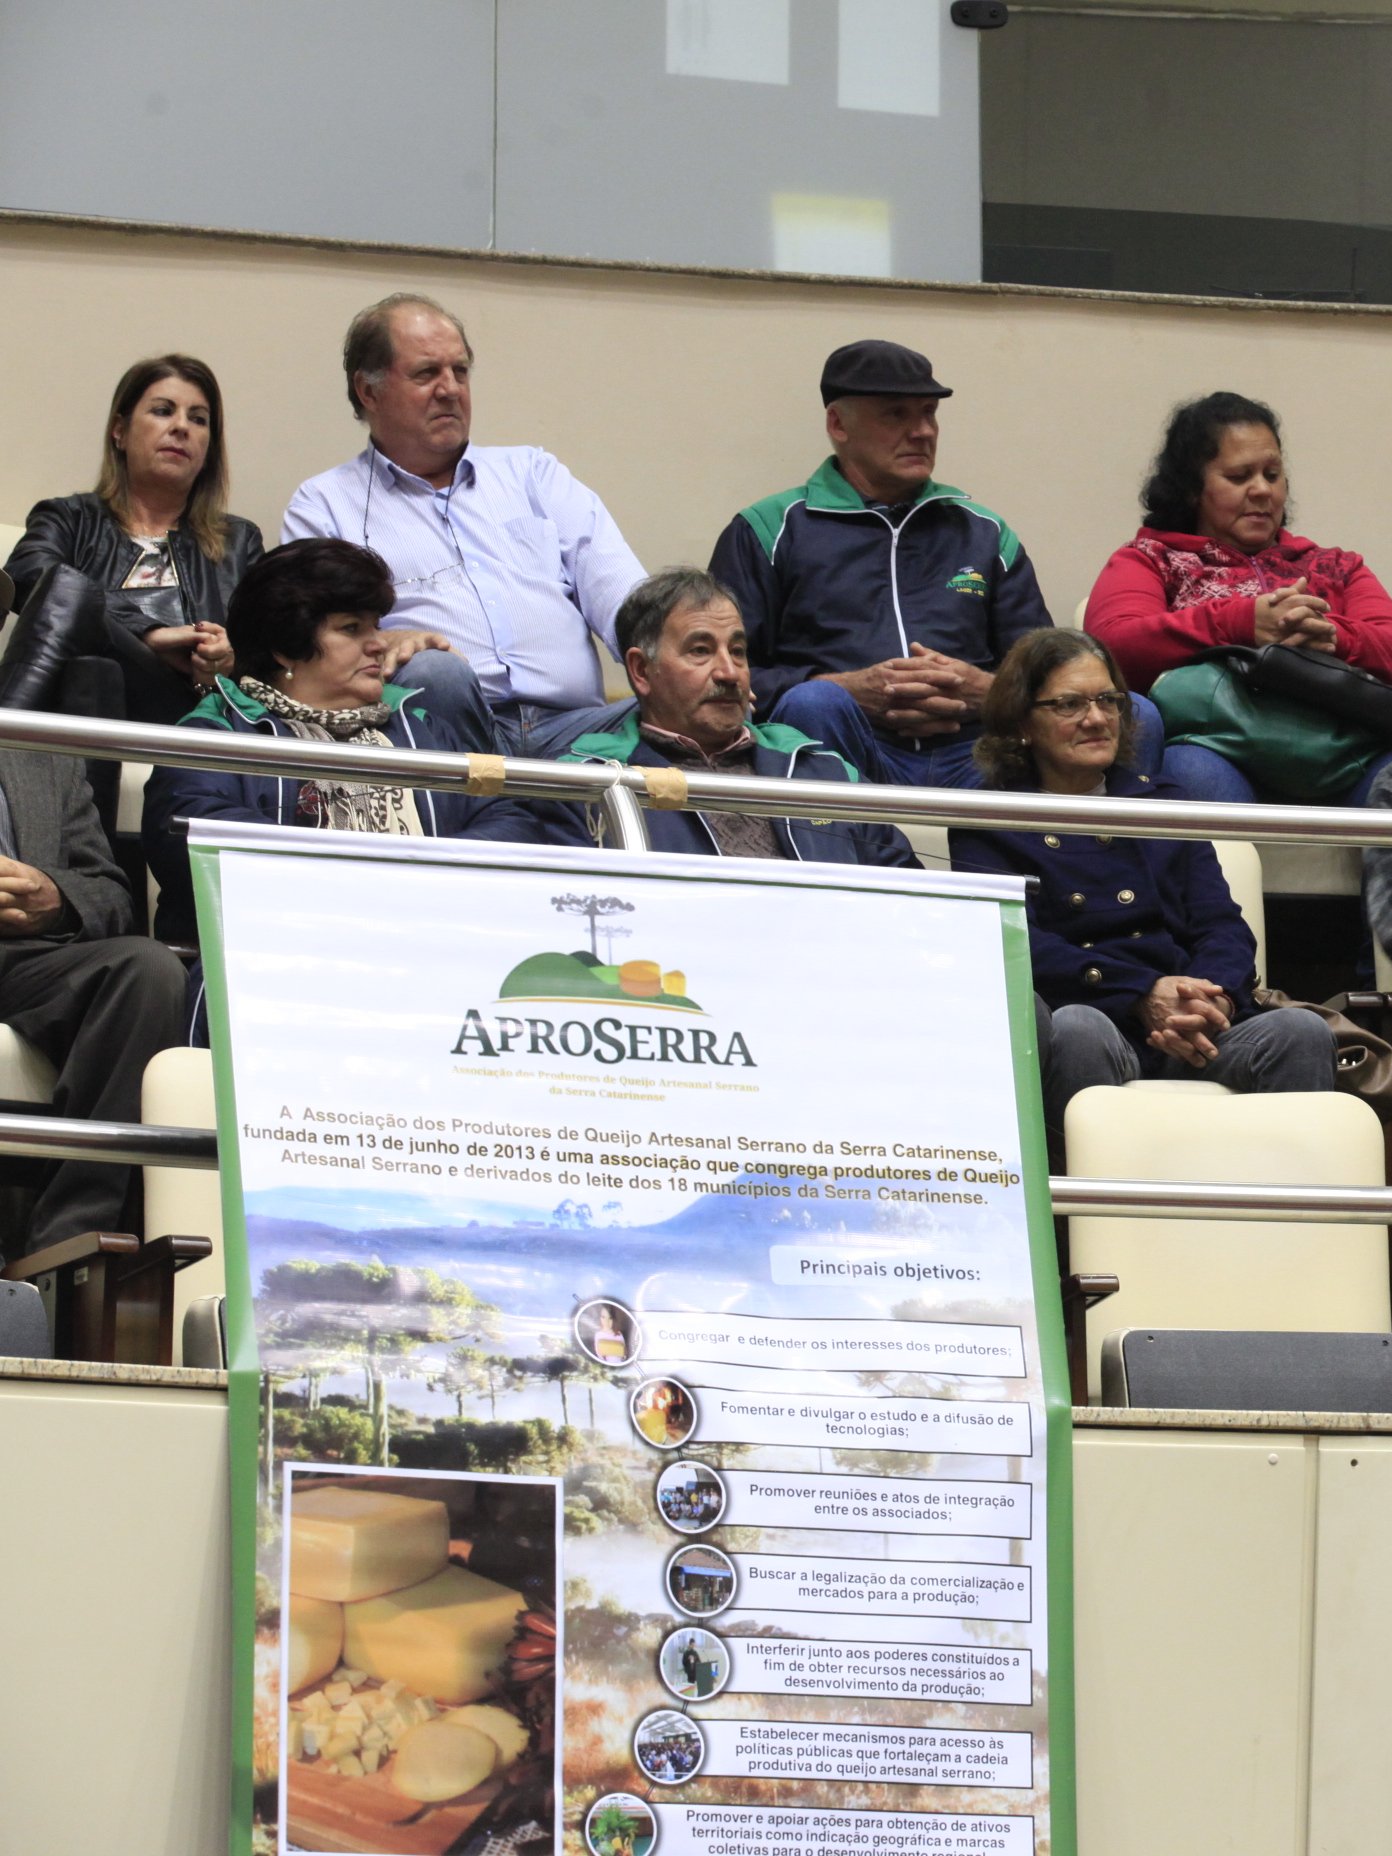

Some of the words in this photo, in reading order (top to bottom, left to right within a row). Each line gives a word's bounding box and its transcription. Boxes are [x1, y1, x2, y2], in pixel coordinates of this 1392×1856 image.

[303, 1107, 408, 1130] Associação
[412, 1116, 446, 1131] dos
[451, 1118, 551, 1139] Produtores
[557, 1126, 579, 1140] de
[584, 1127, 642, 1147] Queijo
[647, 1131, 731, 1150] Artesanal
[737, 1136, 807, 1154] Serrano
[812, 1141, 834, 1155] da
[840, 1141, 887, 1157] Serra
[892, 1143, 1003, 1164] Catarinense,
[243, 1124, 317, 1143] fundada
[323, 1133, 350, 1146] em
[356, 1133, 377, 1148] 13
[382, 1135, 404, 1150] de
[409, 1137, 459, 1155] junho
[467, 1141, 488, 1157] de
[493, 1143, 535, 1160] 2013
[556, 1151, 594, 1164] uma
[600, 1152, 701, 1173] associação
[706, 1160, 739, 1175] que
[744, 1161, 828, 1180] congrega
[832, 1165, 932, 1181] produtores
[937, 1167, 958, 1182] de
[963, 1168, 1020, 1187] Queijo
[281, 1148, 366, 1169] Artesanal
[371, 1156, 442, 1175] Serrano
[464, 1164, 552, 1183] derivados
[558, 1170, 580, 1185] do
[586, 1172, 623, 1188] leite
[629, 1175, 662, 1190] dos
[667, 1176, 688, 1192] 18
[693, 1180, 791, 1199] municípios
[797, 1183, 819, 1199] da
[824, 1184, 871, 1200] Serra
[877, 1186, 988, 1205] Catarinense.
[800, 1258, 887, 1279] Principais
[893, 1261, 981, 1283] objetivos:
[658, 1329, 730, 1346] Congregar
[749, 1334, 806, 1350] defender
[811, 1339, 827, 1350] os
[831, 1339, 903, 1351] interesses
[906, 1340, 931, 1352] dos
[934, 1341, 1012, 1358] produtores;
[721, 1401, 784, 1417] Fomentar
[800, 1406, 855, 1422] divulgar
[870, 1410, 917, 1422] estudo
[944, 1412, 994, 1426] difusão
[997, 1414, 1014, 1426] de
[825, 1422, 909, 1439] tecnologias;
[750, 1484, 816, 1498] Promover
[819, 1487, 877, 1502] reuniões
[892, 1491, 919, 1504] atos
[923, 1493, 940, 1505] de
[944, 1493, 1015, 1510] integração
[814, 1504, 848, 1515] entre
[852, 1507, 868, 1516] os
[872, 1506, 952, 1522] associados;
[749, 1567, 796, 1581] Buscar
[811, 1570, 886, 1587] legalização
[890, 1573, 906, 1586] da
[910, 1576, 1014, 1593] comercialização
[798, 1585, 864, 1599] mercados
[868, 1590, 897, 1602] para
[913, 1589, 979, 1606] produção;
[746, 1643, 805, 1657] Interferir
[808, 1645, 842, 1660] junto
[846, 1649, 870, 1659] aos
[874, 1649, 928, 1663] poderes
[932, 1649, 1009, 1666] constituídos
[763, 1660, 785, 1672] fim
[789, 1660, 805, 1673] de
[809, 1661, 842, 1674] obter
[847, 1665, 906, 1676] recursos
[910, 1664, 986, 1681] necessários
[989, 1671, 1004, 1682] ao
[784, 1676, 899, 1692] desenvolvimento
[902, 1680, 918, 1692] da
[921, 1681, 985, 1697] produção;
[739, 1727, 818, 1742] Estabelecer
[822, 1731, 905, 1745] mecanismos
[909, 1736, 936, 1749] para
[939, 1738, 985, 1750] acesso
[989, 1736, 1004, 1750] às
[735, 1742, 793, 1757] políticas
[796, 1744, 853, 1759] públicas
[856, 1749, 880, 1761] que
[883, 1747, 951, 1764] fortaleçam
[965, 1751, 1008, 1765] cadeia
[748, 1759, 812, 1773] produtiva
[816, 1761, 832, 1773] do
[836, 1763, 877, 1778] queijo
[879, 1764, 938, 1778] artesanal
[941, 1767, 996, 1782] serrano;
[686, 1810, 752, 1824] Promover
[768, 1813, 809, 1827] apoiar
[812, 1815, 852, 1832] ações
[855, 1818, 883, 1830] para
[887, 1818, 948, 1833] obtenção
[950, 1820, 967, 1832] de
[970, 1820, 1011, 1833] ativos
[691, 1826, 762, 1840] territoriais
[765, 1830, 803, 1841] como
[806, 1829, 869, 1846] indicação
[873, 1832, 941, 1848] geográfica
[956, 1837, 1005, 1849] marcas
[708, 1843, 769, 1856] coletivas
